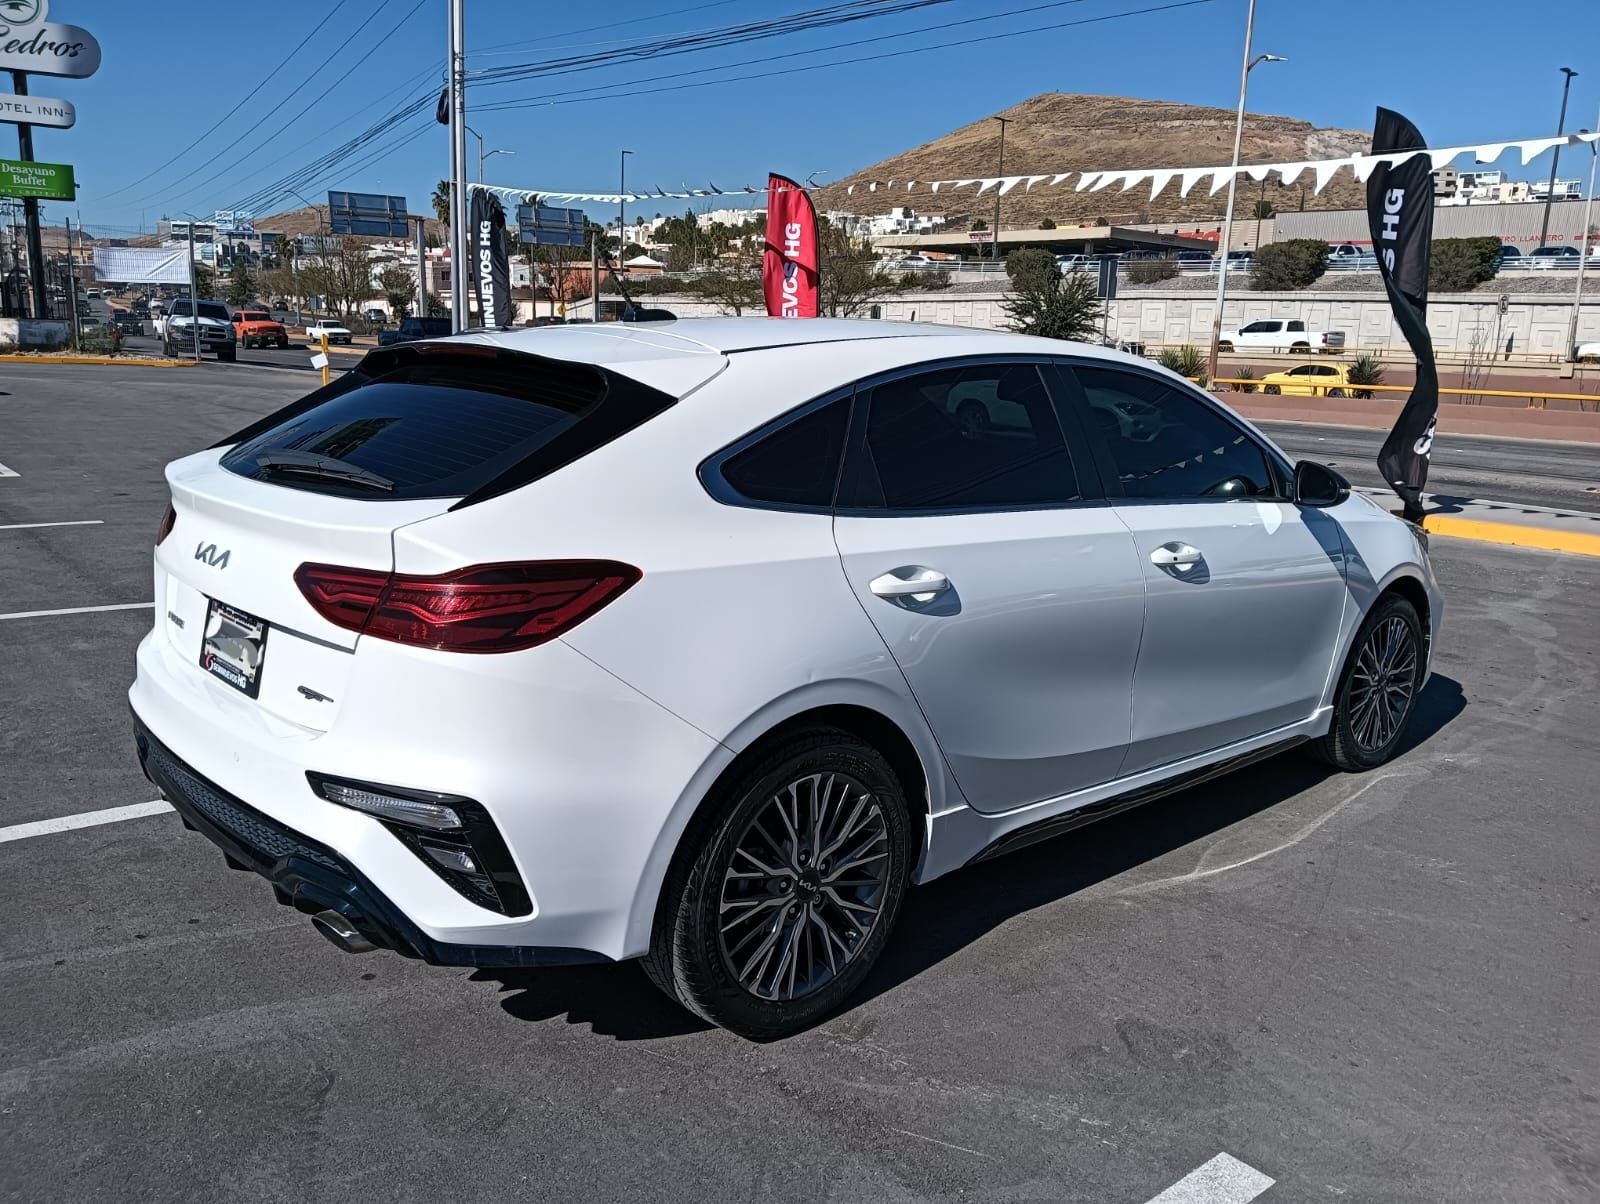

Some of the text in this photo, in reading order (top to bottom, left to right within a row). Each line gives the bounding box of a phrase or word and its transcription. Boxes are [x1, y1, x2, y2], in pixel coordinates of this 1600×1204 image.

[38, 106, 64, 117] INN
[1, 163, 56, 177] Desayuno
[12, 174, 47, 186] Buffet
[1382, 188, 1405, 241] HG
[1519, 234, 1564, 242] LLANERO
[480, 220, 496, 328] INUEVOS HG
[781, 223, 801, 319] EVOS HG
[194, 540, 231, 570] KIA
